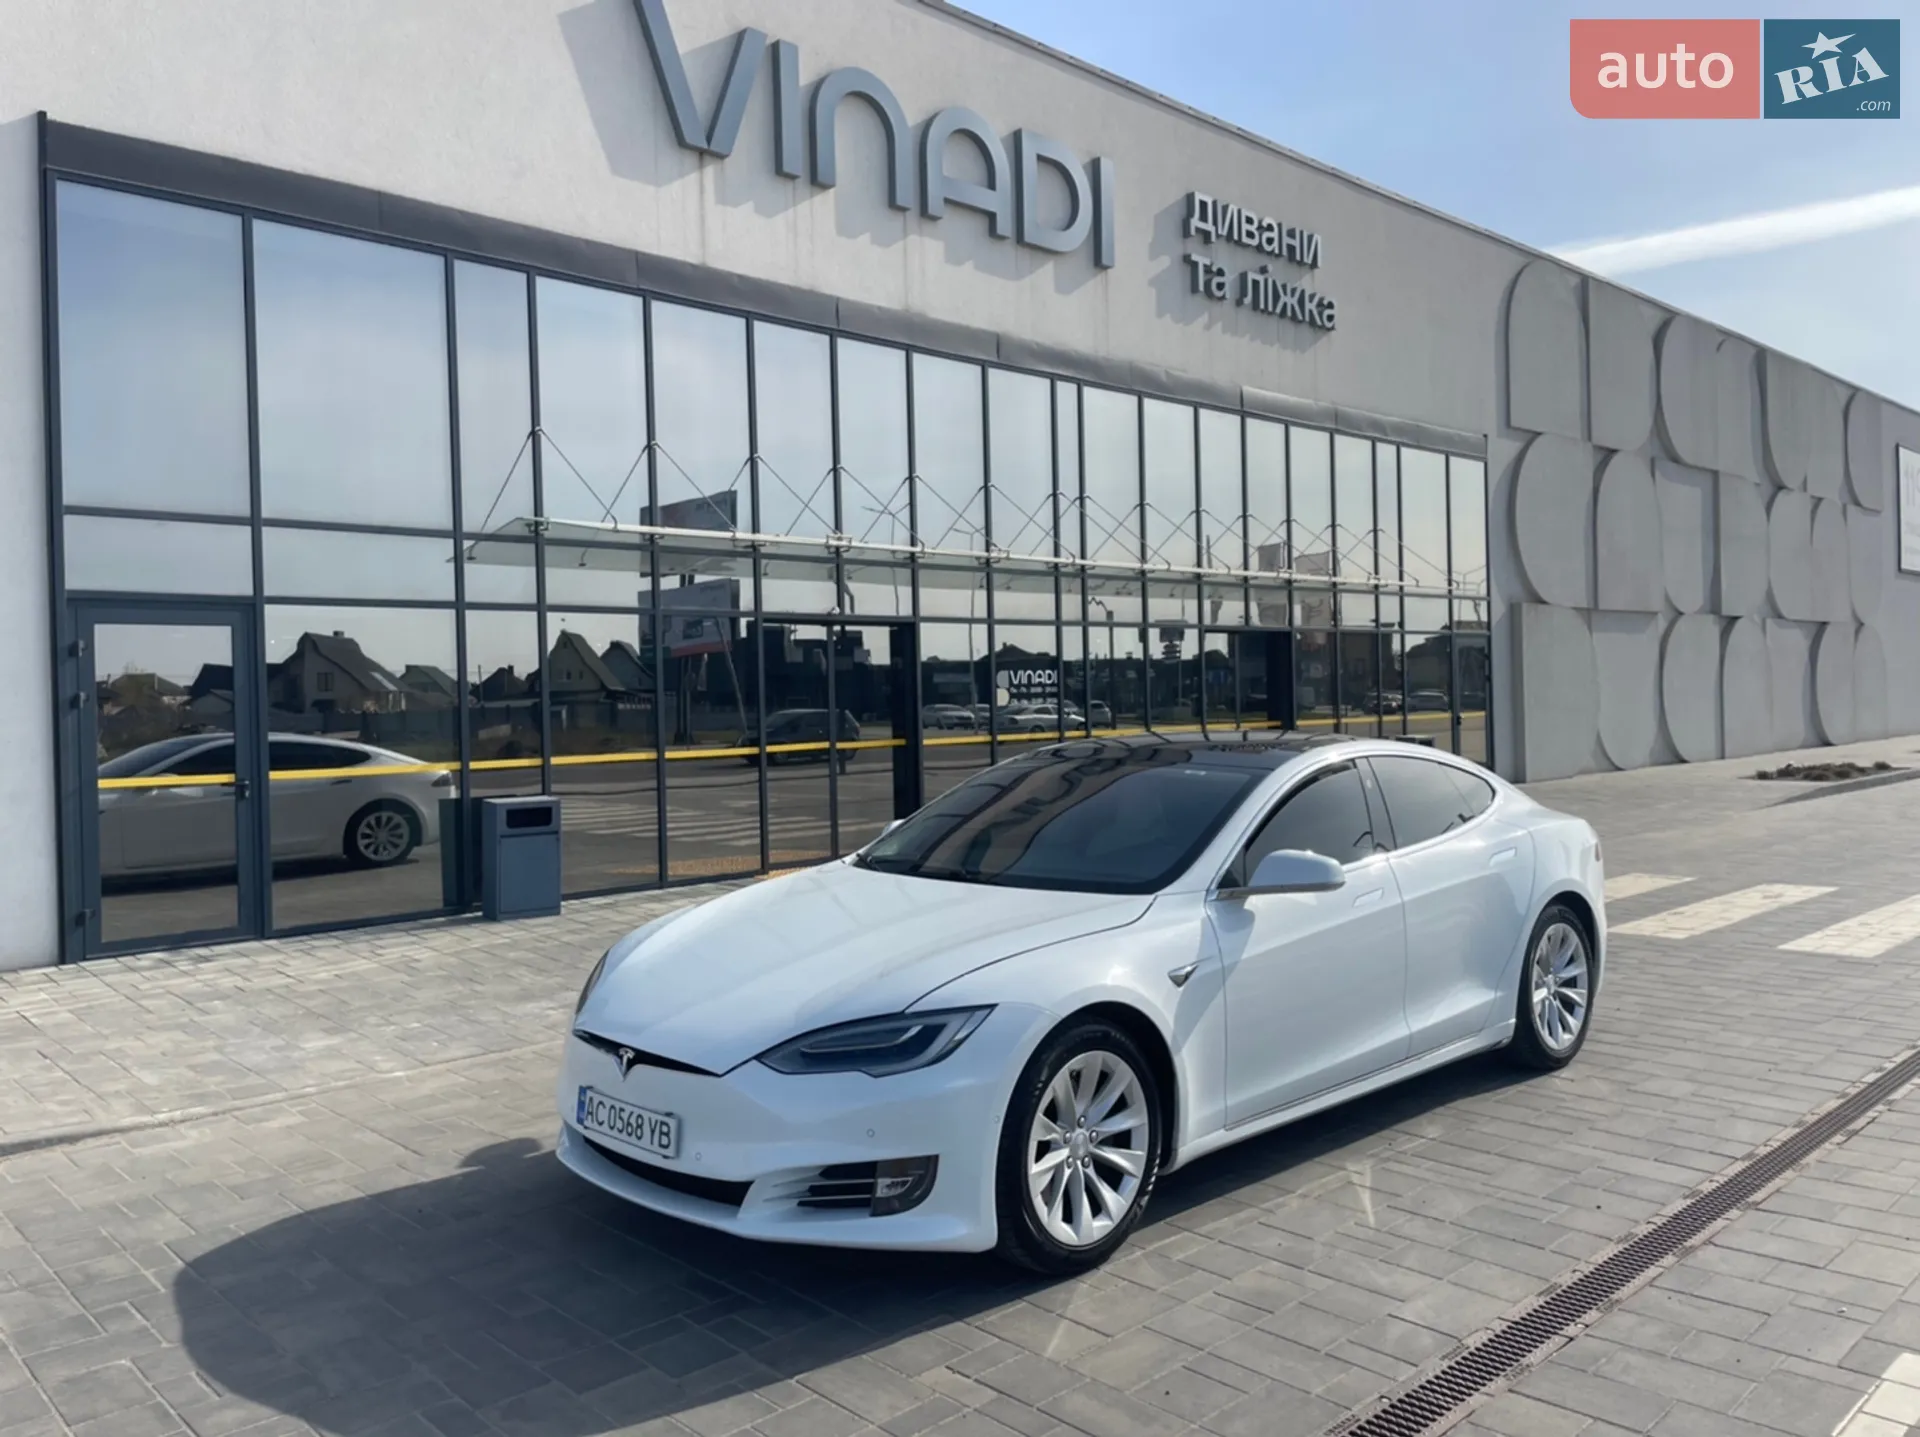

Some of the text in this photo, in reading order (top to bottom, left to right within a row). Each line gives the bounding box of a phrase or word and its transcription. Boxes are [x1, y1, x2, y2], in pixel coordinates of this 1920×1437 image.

[634, 0, 1115, 270] VINADI
[1184, 190, 1322, 269] дивани
[1184, 253, 1337, 331] та ліжка
[1009, 669, 1058, 684] VINADI
[585, 1096, 672, 1150] AC 0568 YB
